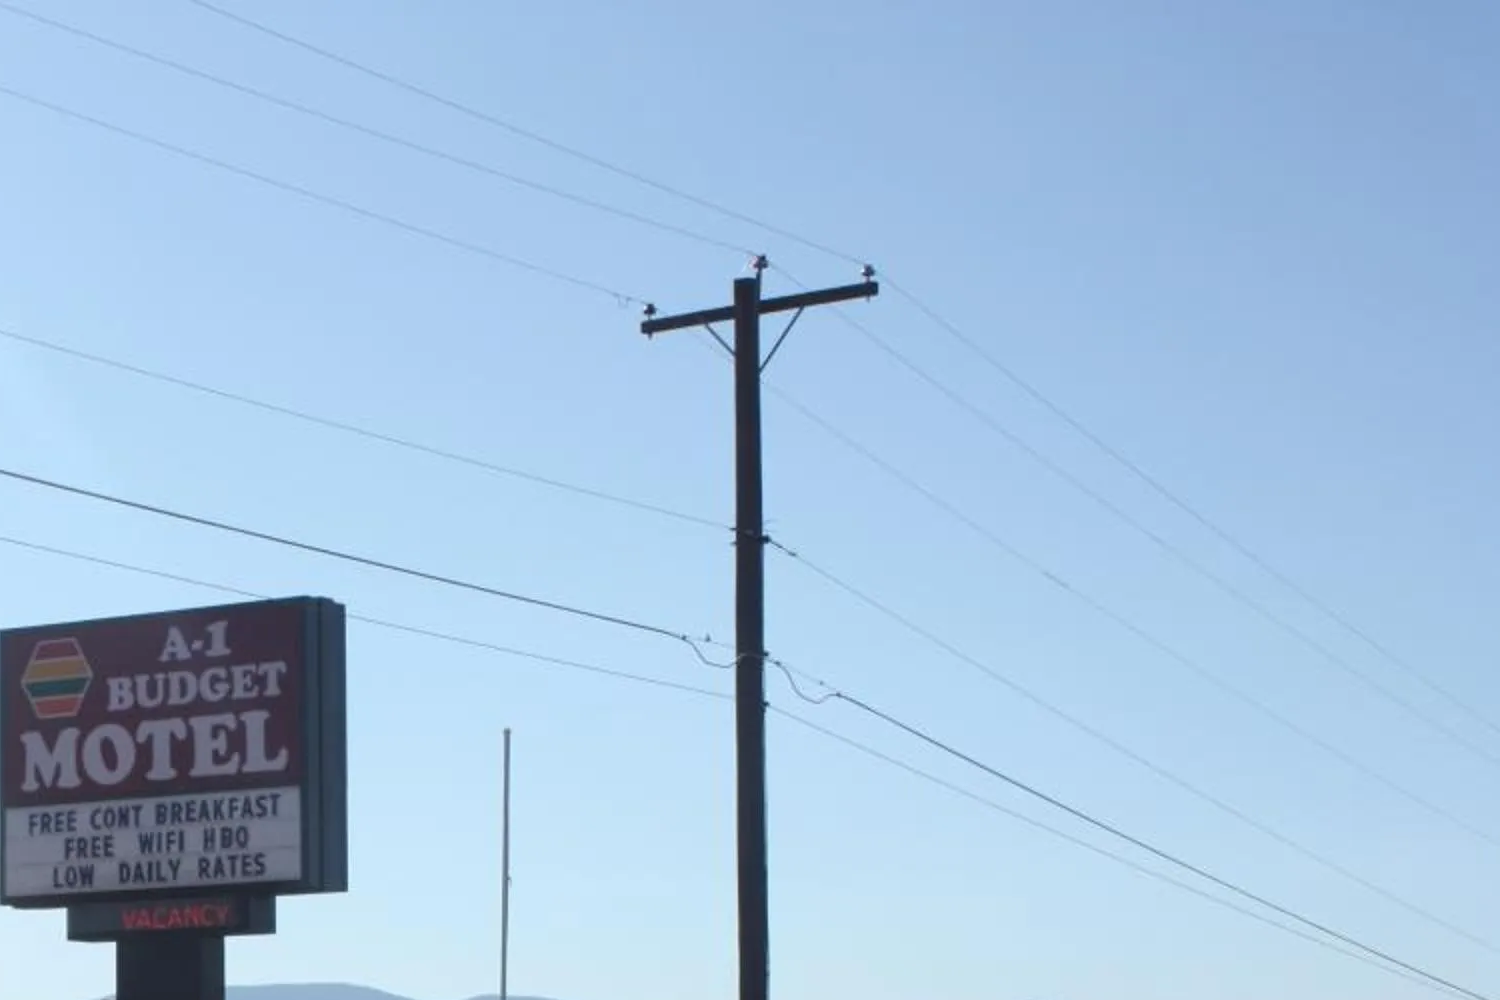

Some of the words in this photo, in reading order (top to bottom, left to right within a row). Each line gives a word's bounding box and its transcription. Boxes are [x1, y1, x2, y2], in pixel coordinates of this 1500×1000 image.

[158, 620, 232, 662] A-1
[106, 661, 287, 712] BUDGET
[19, 709, 289, 792] MOTEL
[28, 811, 77, 837] FREE
[90, 805, 142, 831] CONT
[155, 793, 282, 827] BREAKFAST
[64, 834, 116, 861] FREE
[138, 829, 186, 855] WIFI
[203, 826, 250, 852] HBO
[52, 864, 95, 889] LOW
[118, 859, 182, 885] DAILY
[198, 852, 267, 880] RATES
[121, 904, 232, 931] VACANCY
